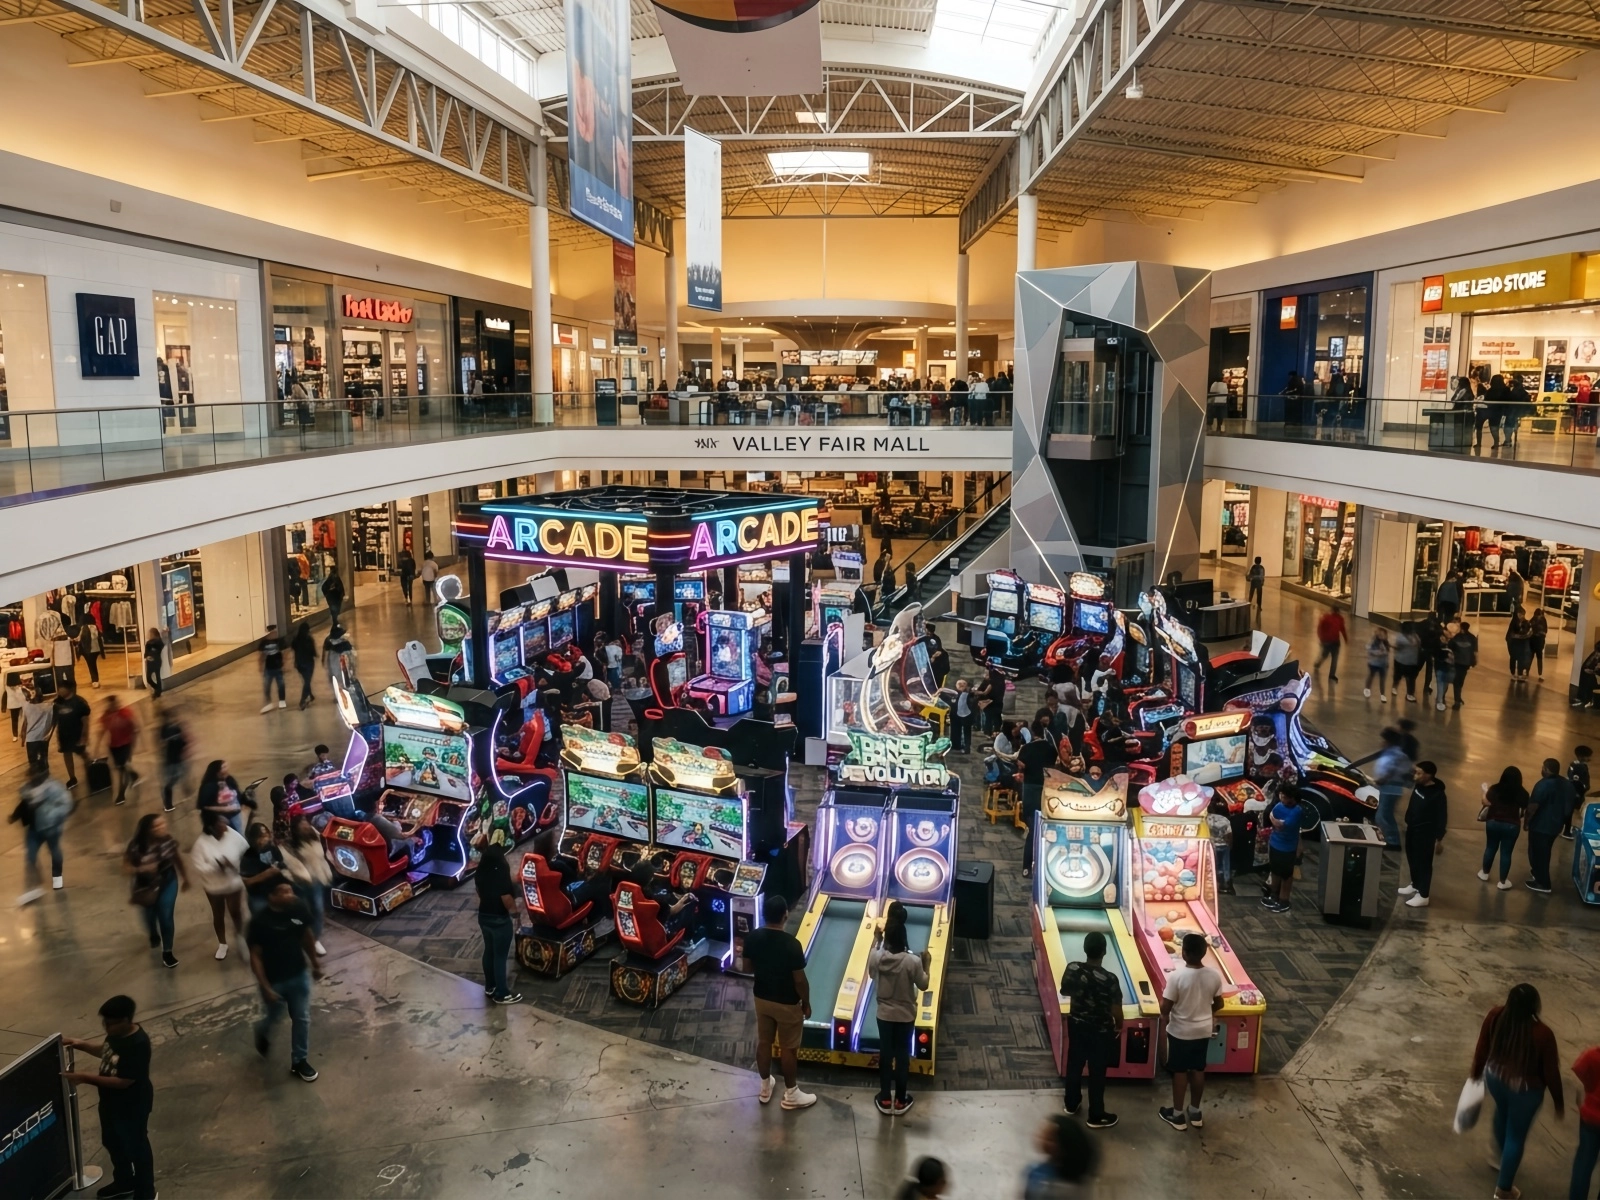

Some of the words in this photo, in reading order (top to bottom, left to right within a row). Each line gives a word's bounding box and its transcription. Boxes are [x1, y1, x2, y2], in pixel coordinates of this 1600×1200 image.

[94, 315, 128, 356] GAP
[732, 436, 812, 452] VALLEY
[819, 436, 866, 452] FAIR
[873, 436, 931, 452] MALL
[485, 513, 650, 564] ARCADE
[688, 506, 819, 561] ARCADE
